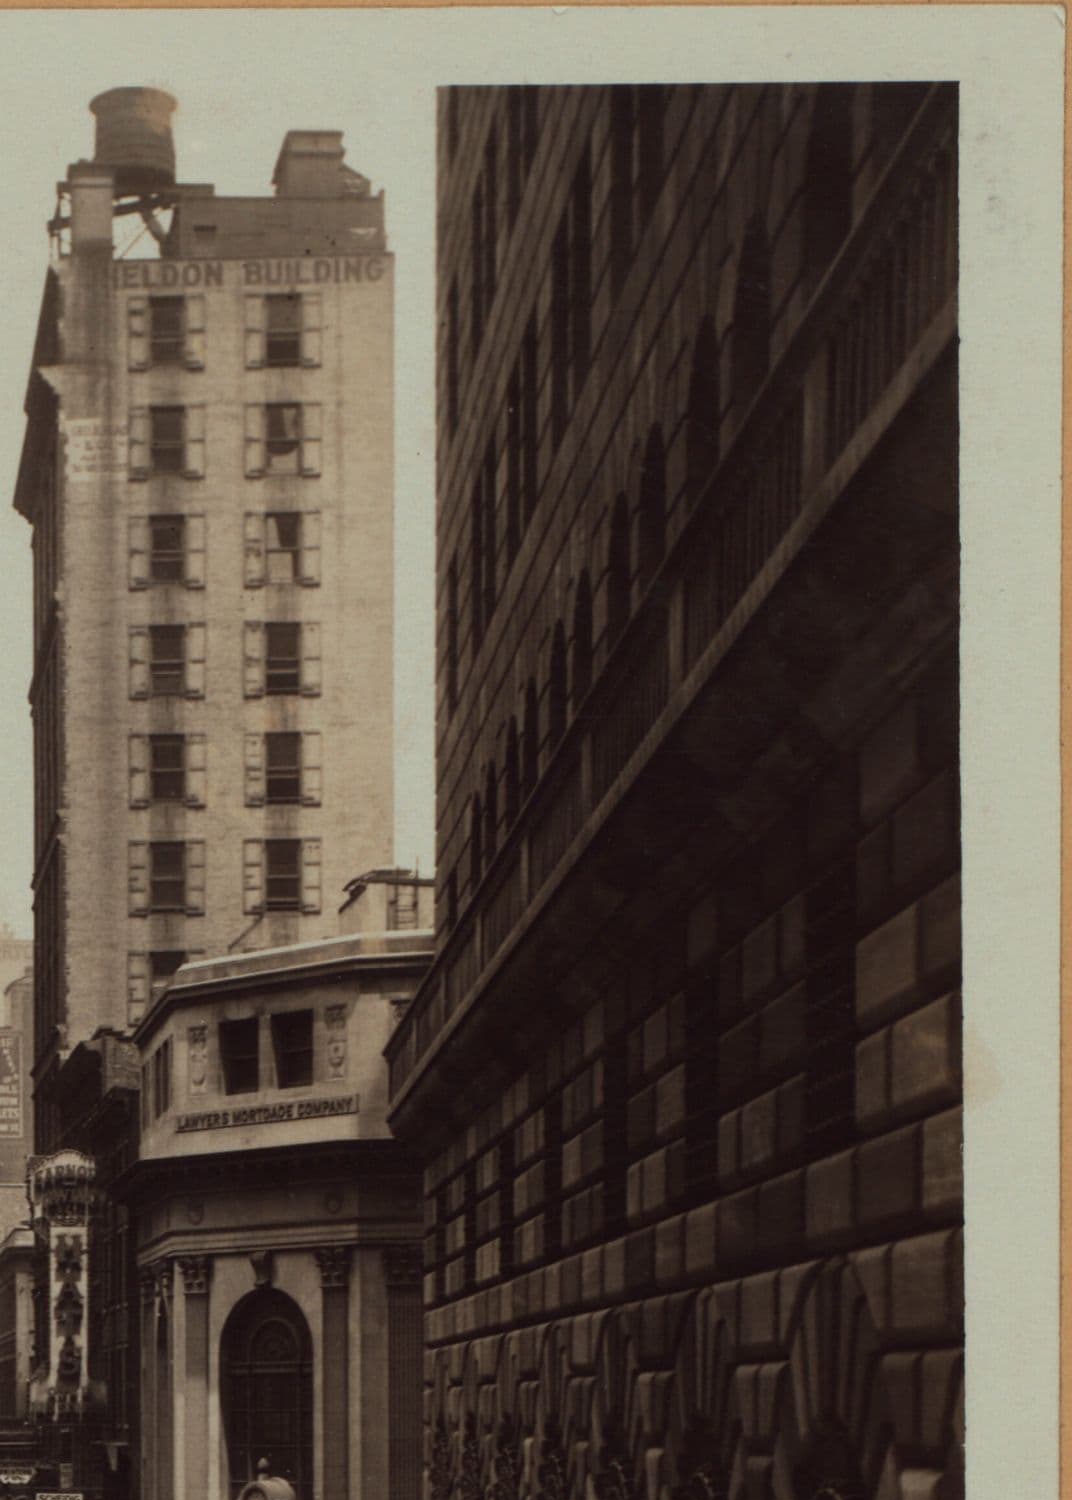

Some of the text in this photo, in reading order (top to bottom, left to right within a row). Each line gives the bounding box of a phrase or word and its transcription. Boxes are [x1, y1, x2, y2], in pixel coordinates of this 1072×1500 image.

[243, 258, 384, 286] BUILDING
[177, 1112, 229, 1130] LAWYERS
[297, 1096, 354, 1118] COMPANY
